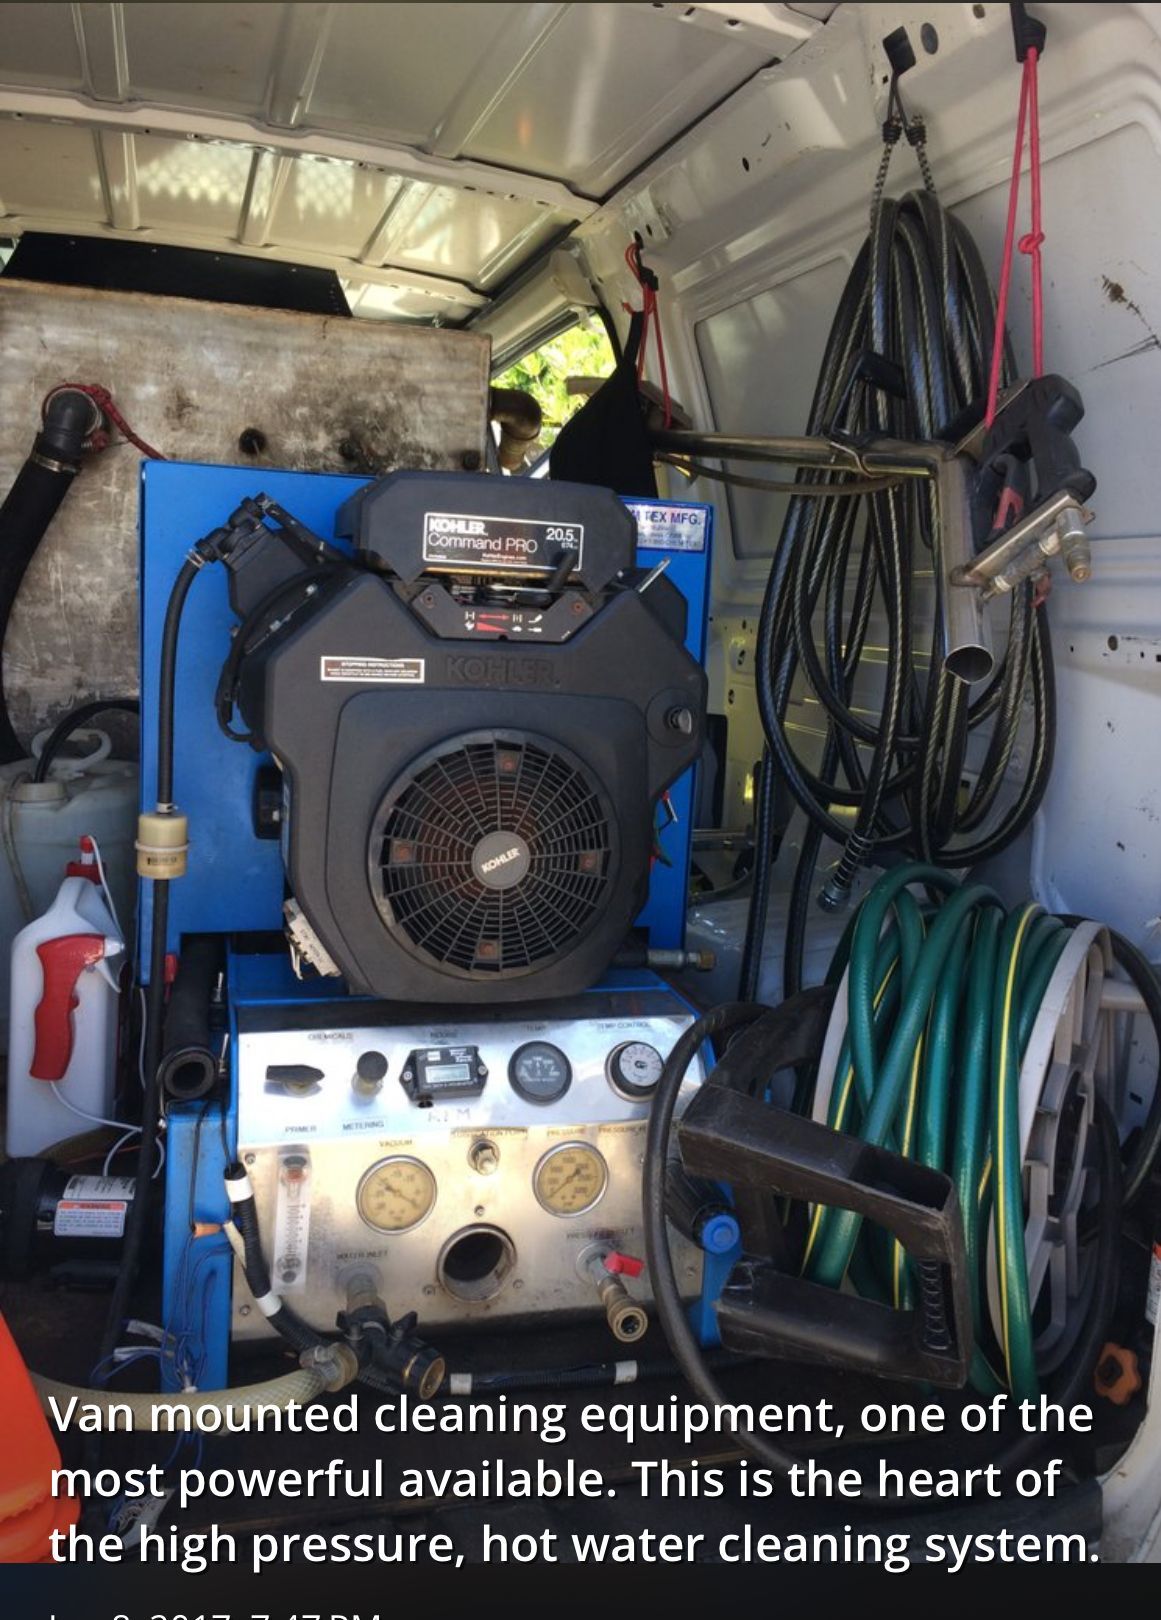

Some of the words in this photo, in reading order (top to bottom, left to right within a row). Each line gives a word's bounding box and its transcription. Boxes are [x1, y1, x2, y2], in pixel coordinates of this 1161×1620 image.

[671, 512, 702, 525] MFG.
[428, 517, 486, 534] KOHLER
[546, 527, 574, 542] 20.5
[428, 532, 501, 551] Command
[505, 537, 538, 553] PRO
[446, 654, 555, 686] KOHLER
[481, 847, 520, 874] KOHLER
[284, 1125, 317, 1133] PRIMER
[342, 1121, 384, 1130] METERING
[379, 1139, 413, 1147] VACUUM
